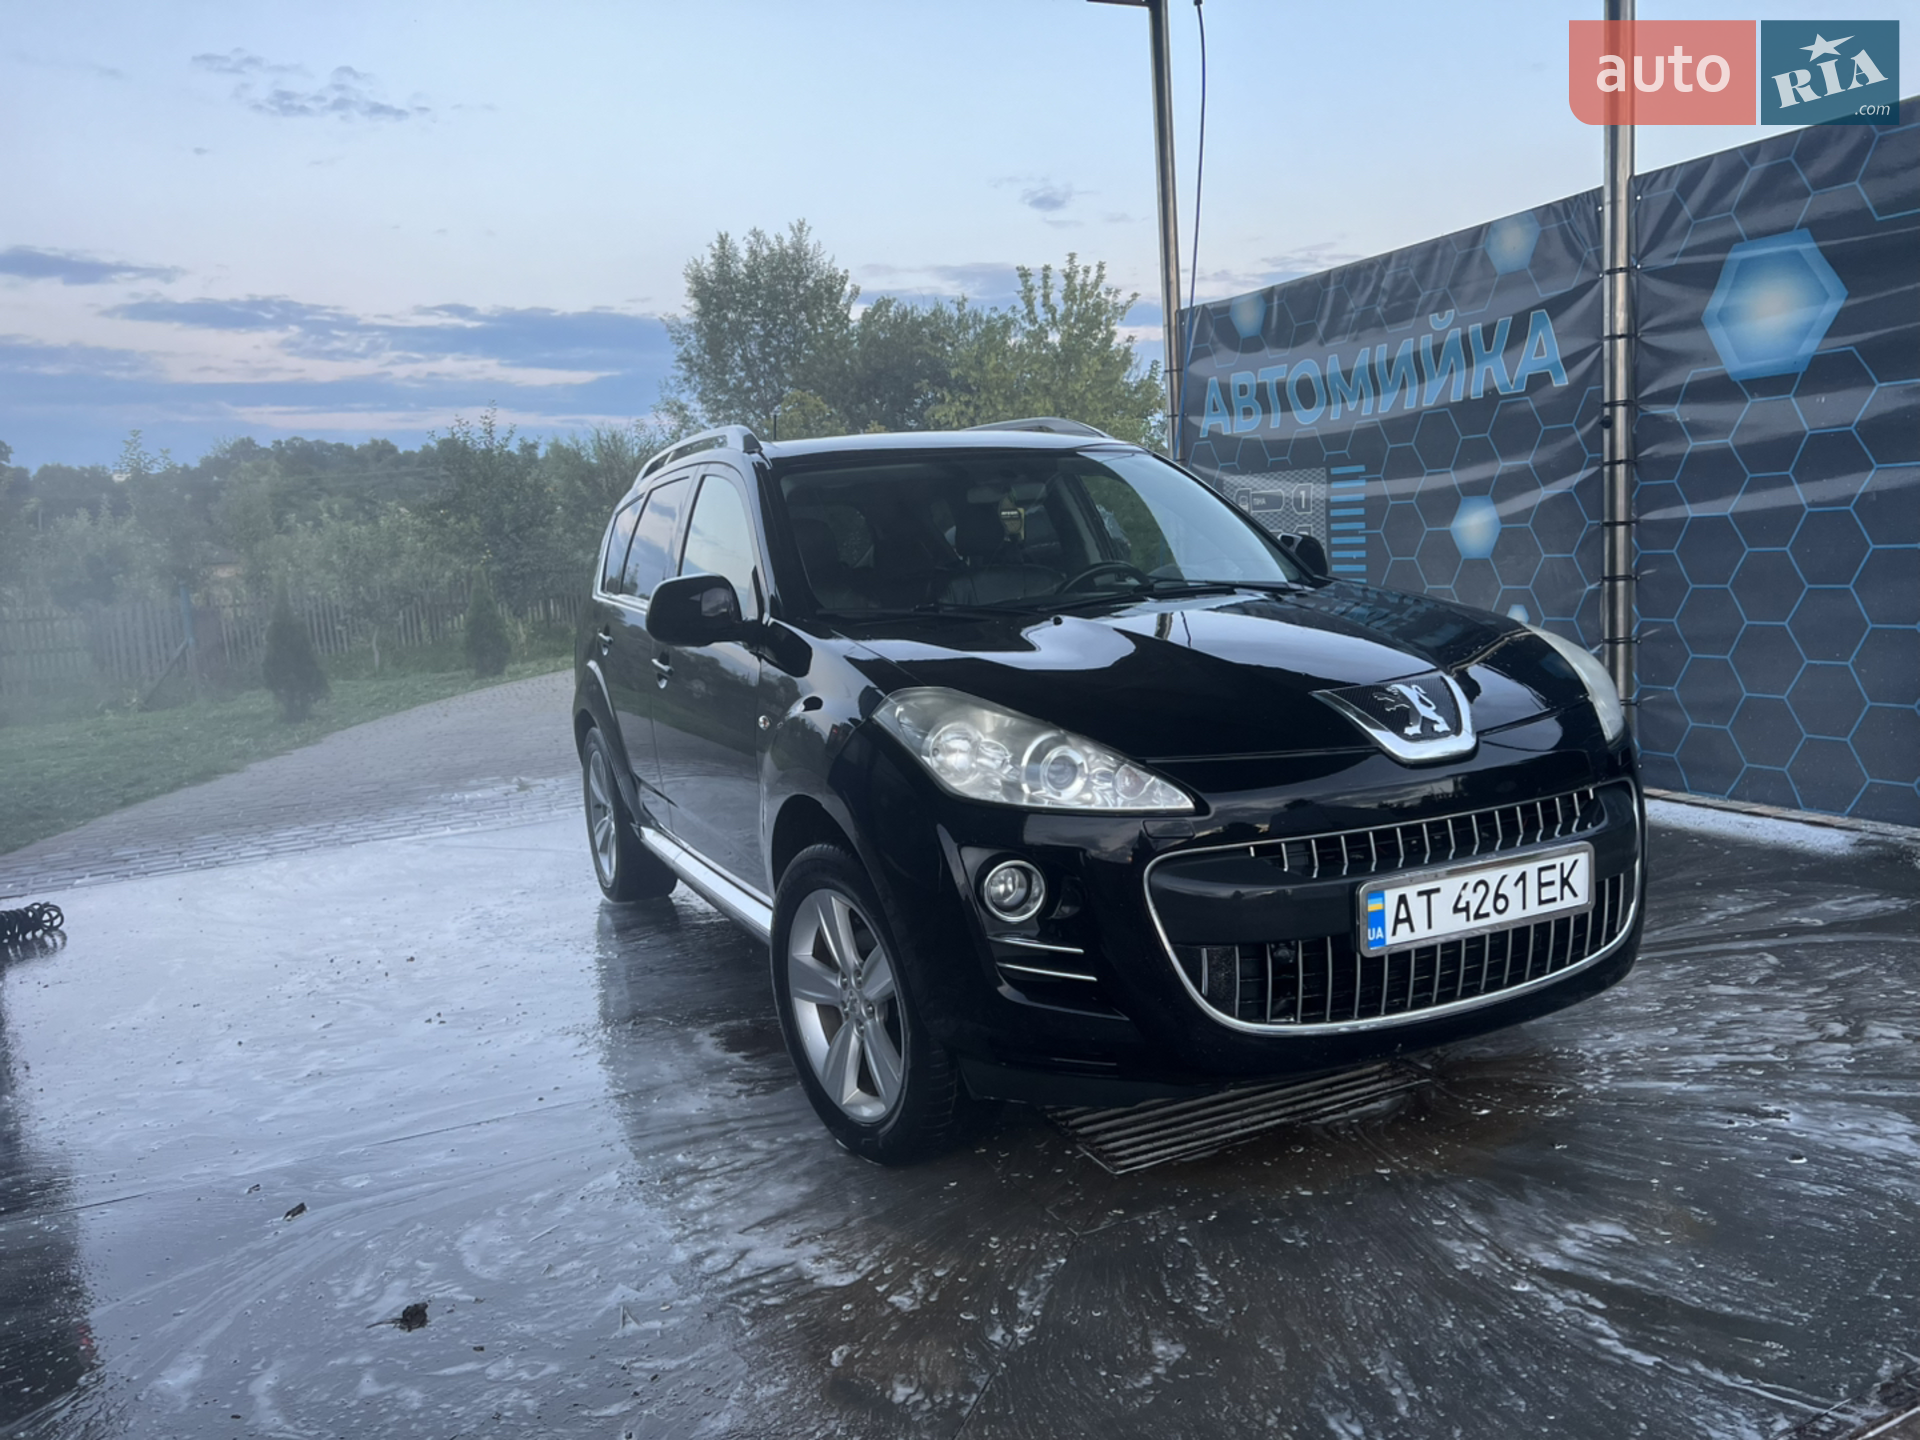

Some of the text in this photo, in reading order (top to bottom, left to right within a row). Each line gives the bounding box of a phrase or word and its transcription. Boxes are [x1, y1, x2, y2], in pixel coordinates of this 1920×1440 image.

[1199, 308, 1569, 438] АВТОМИЙКА
[1368, 927, 1384, 941] UA
[1391, 859, 1579, 937] AT 4261 EK
